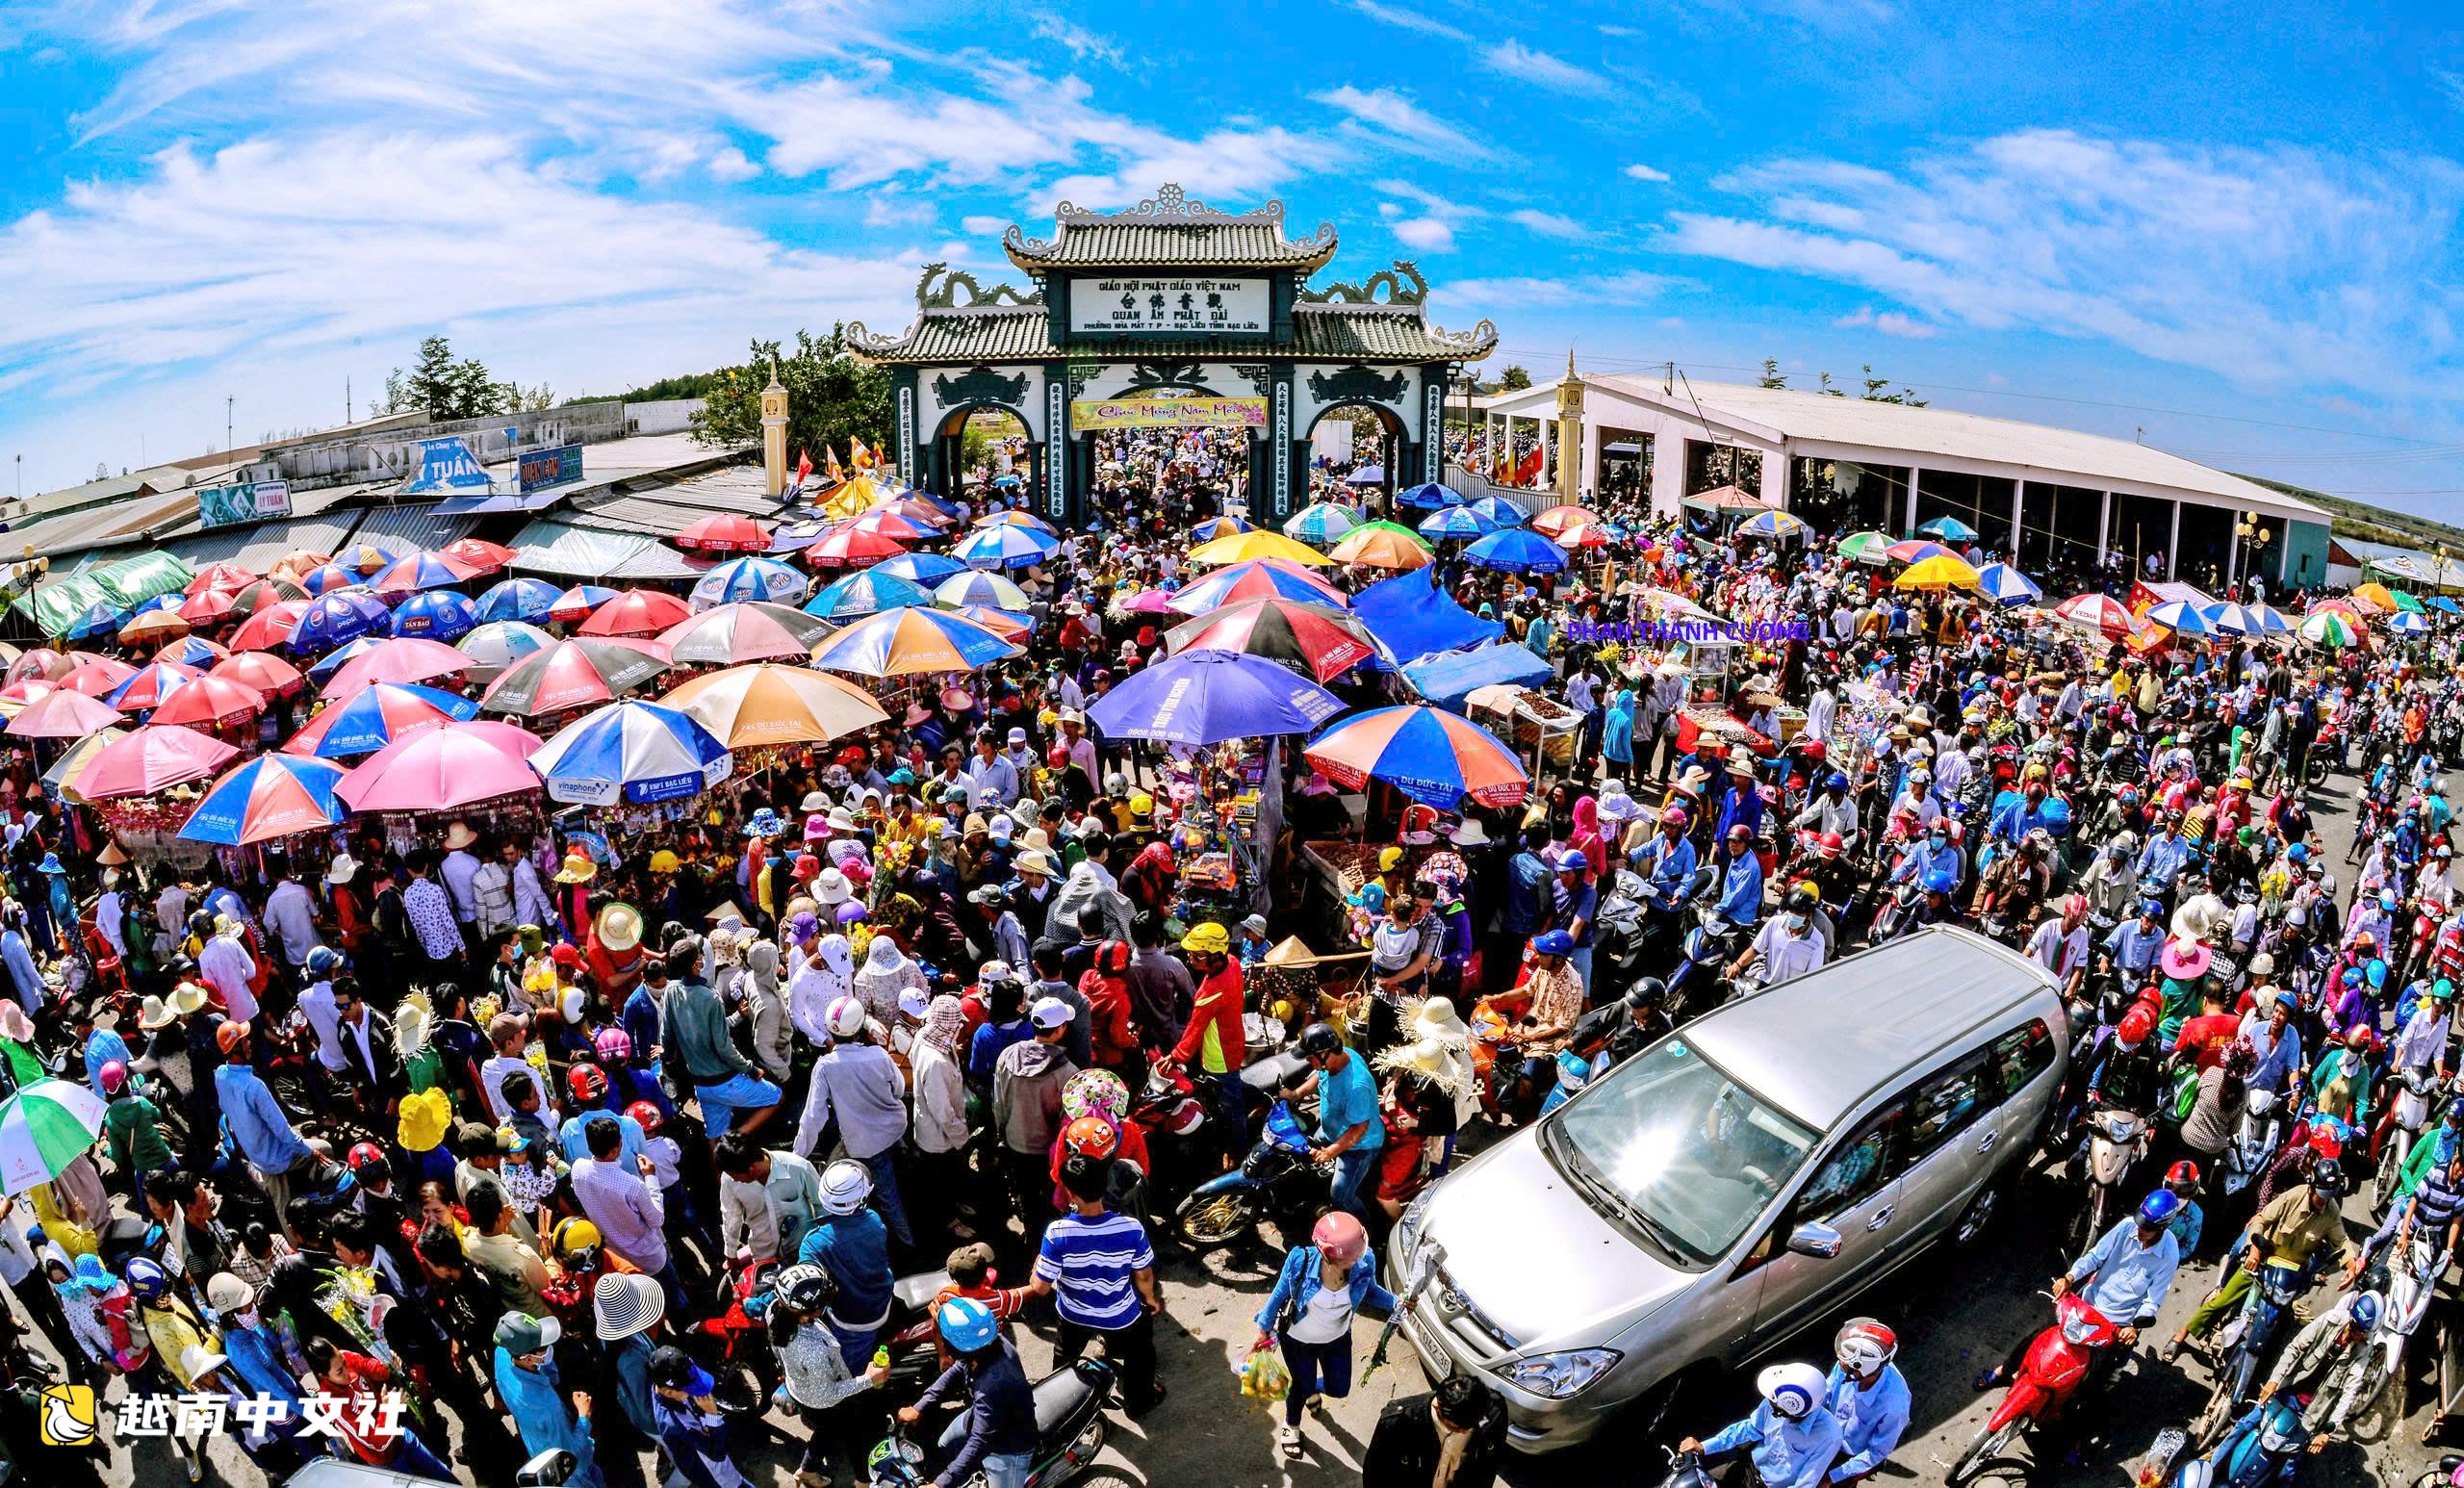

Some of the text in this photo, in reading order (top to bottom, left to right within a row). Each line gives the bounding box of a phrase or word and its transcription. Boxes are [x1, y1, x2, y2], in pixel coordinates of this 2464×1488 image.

[1098, 279, 1241, 294] GIÁO HỘI PHẬT GIÁO VIỆT NAM
[1112, 308, 1228, 323] QUAN ÂM PHẬT ĐÀI
[337, 616, 357, 629] pepsi
[558, 782, 597, 793] vinaphone
[1439, 782, 1454, 793] TÀI
